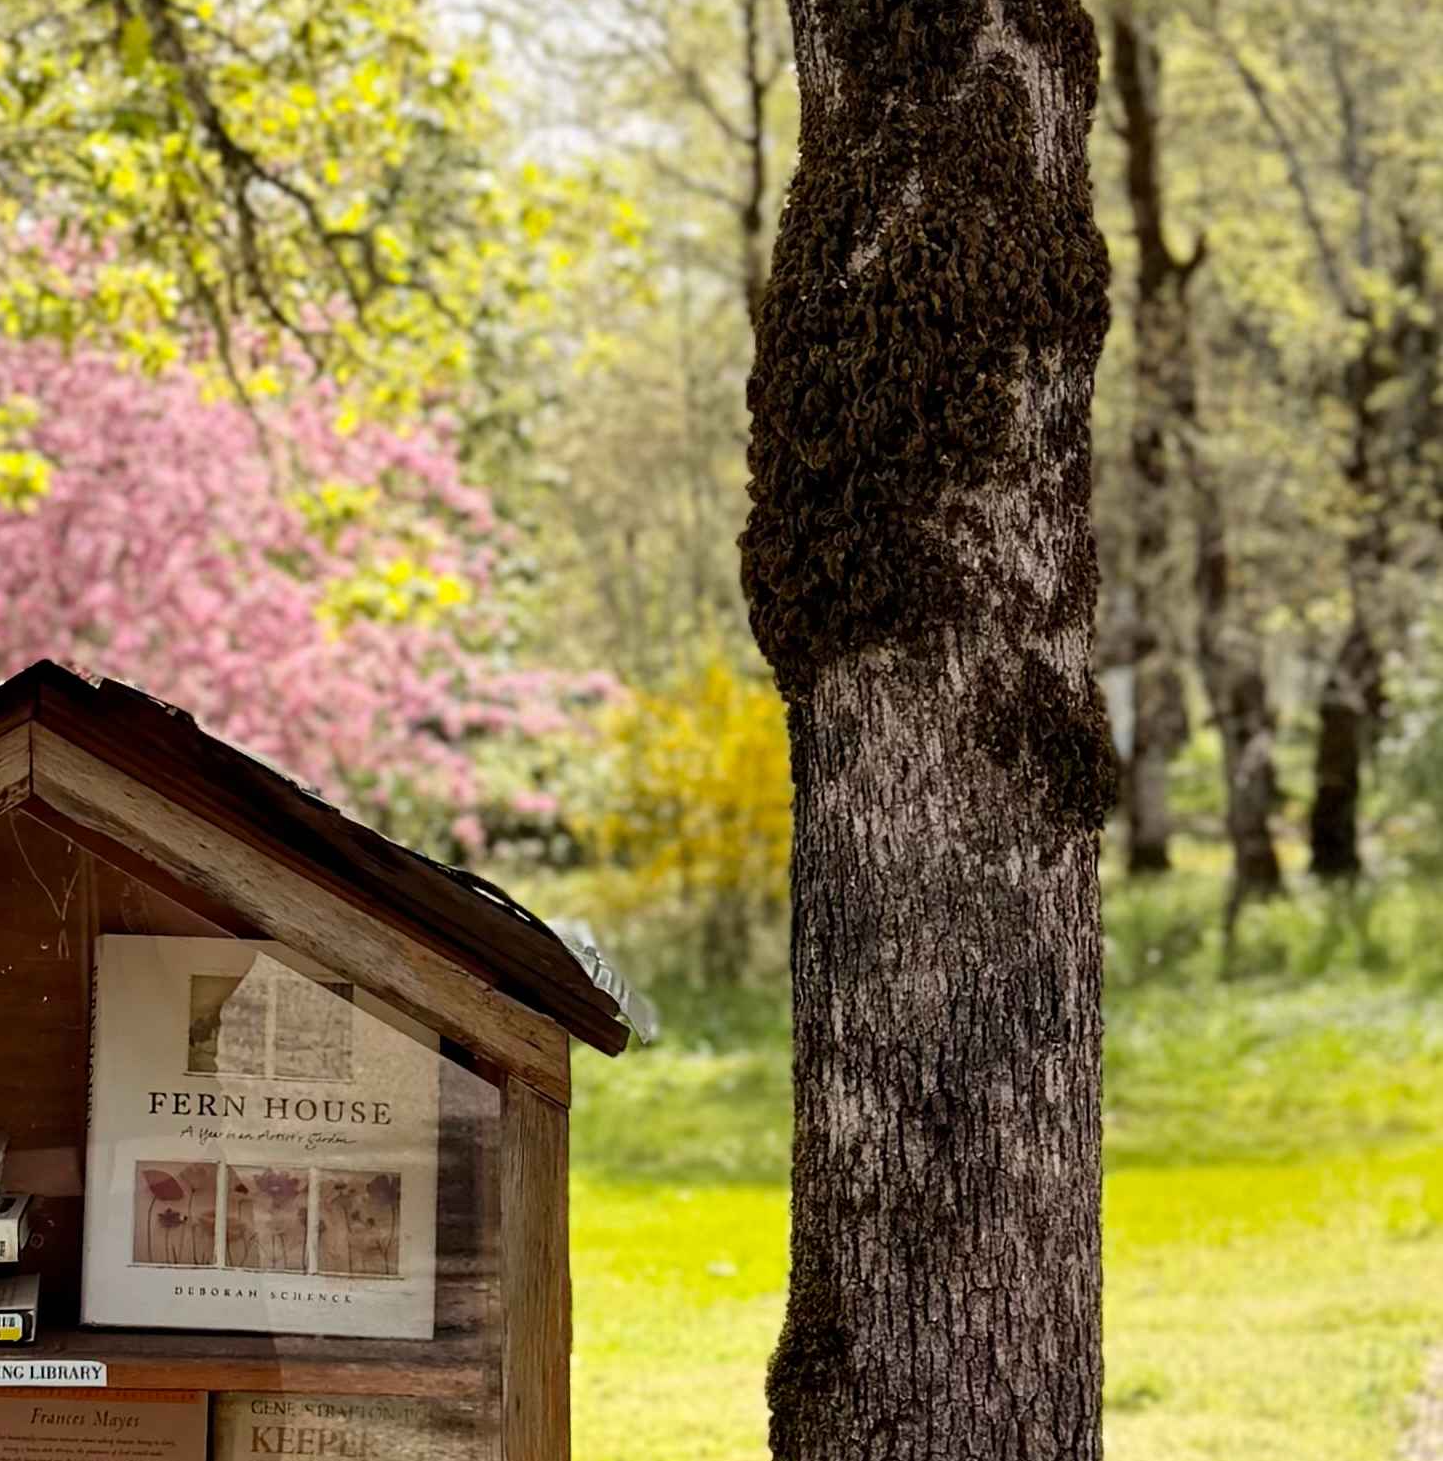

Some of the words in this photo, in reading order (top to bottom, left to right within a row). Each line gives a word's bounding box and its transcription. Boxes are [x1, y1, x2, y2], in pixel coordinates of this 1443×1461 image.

[148, 1091, 247, 1117] FERN
[263, 1096, 393, 1125] HOUSE
[174, 1286, 258, 1298] DEBORAH
[30, 1364, 103, 1380] LIBRARY
[251, 1399, 296, 1417] GENE
[30, 1406, 86, 1426] Frances
[93, 1410, 141, 1433] Mayes
[251, 1425, 379, 1458] KEEPER
